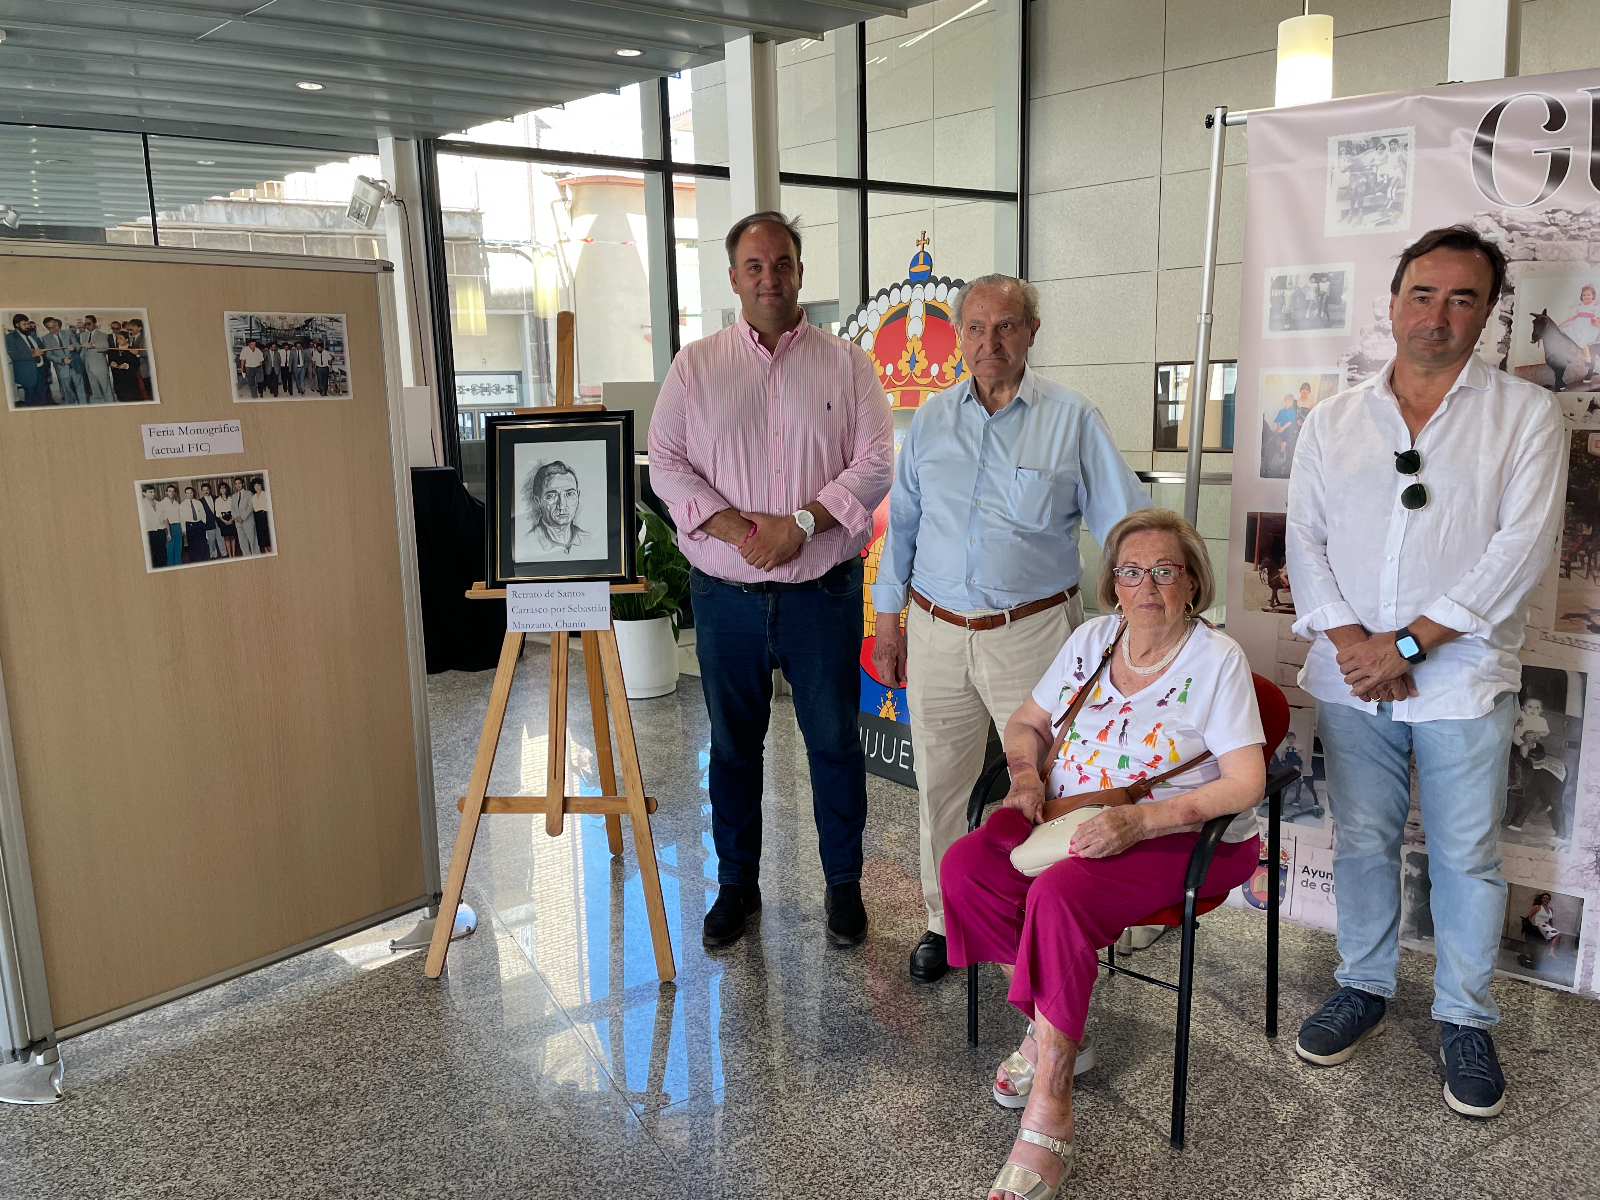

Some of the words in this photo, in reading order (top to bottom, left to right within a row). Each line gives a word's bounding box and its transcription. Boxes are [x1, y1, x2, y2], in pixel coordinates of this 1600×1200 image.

[1471, 86, 1600, 209] G
[148, 426, 175, 437] Feria
[178, 423, 240, 437] Monográfica
[151, 443, 185, 457] (actual
[188, 442, 211, 454] FIC)
[511, 590, 542, 599] Retrato
[544, 589, 555, 598] de
[557, 589, 586, 598] Santos
[511, 605, 549, 614] Carrasco
[550, 607, 566, 616] por
[567, 603, 607, 613] Sebastián
[512, 620, 553, 630] Manzano,
[555, 619, 586, 629] Chanín
[859, 726, 917, 772] IJUE
[1301, 865, 1334, 881] Ayun
[1300, 878, 1317, 890] de
